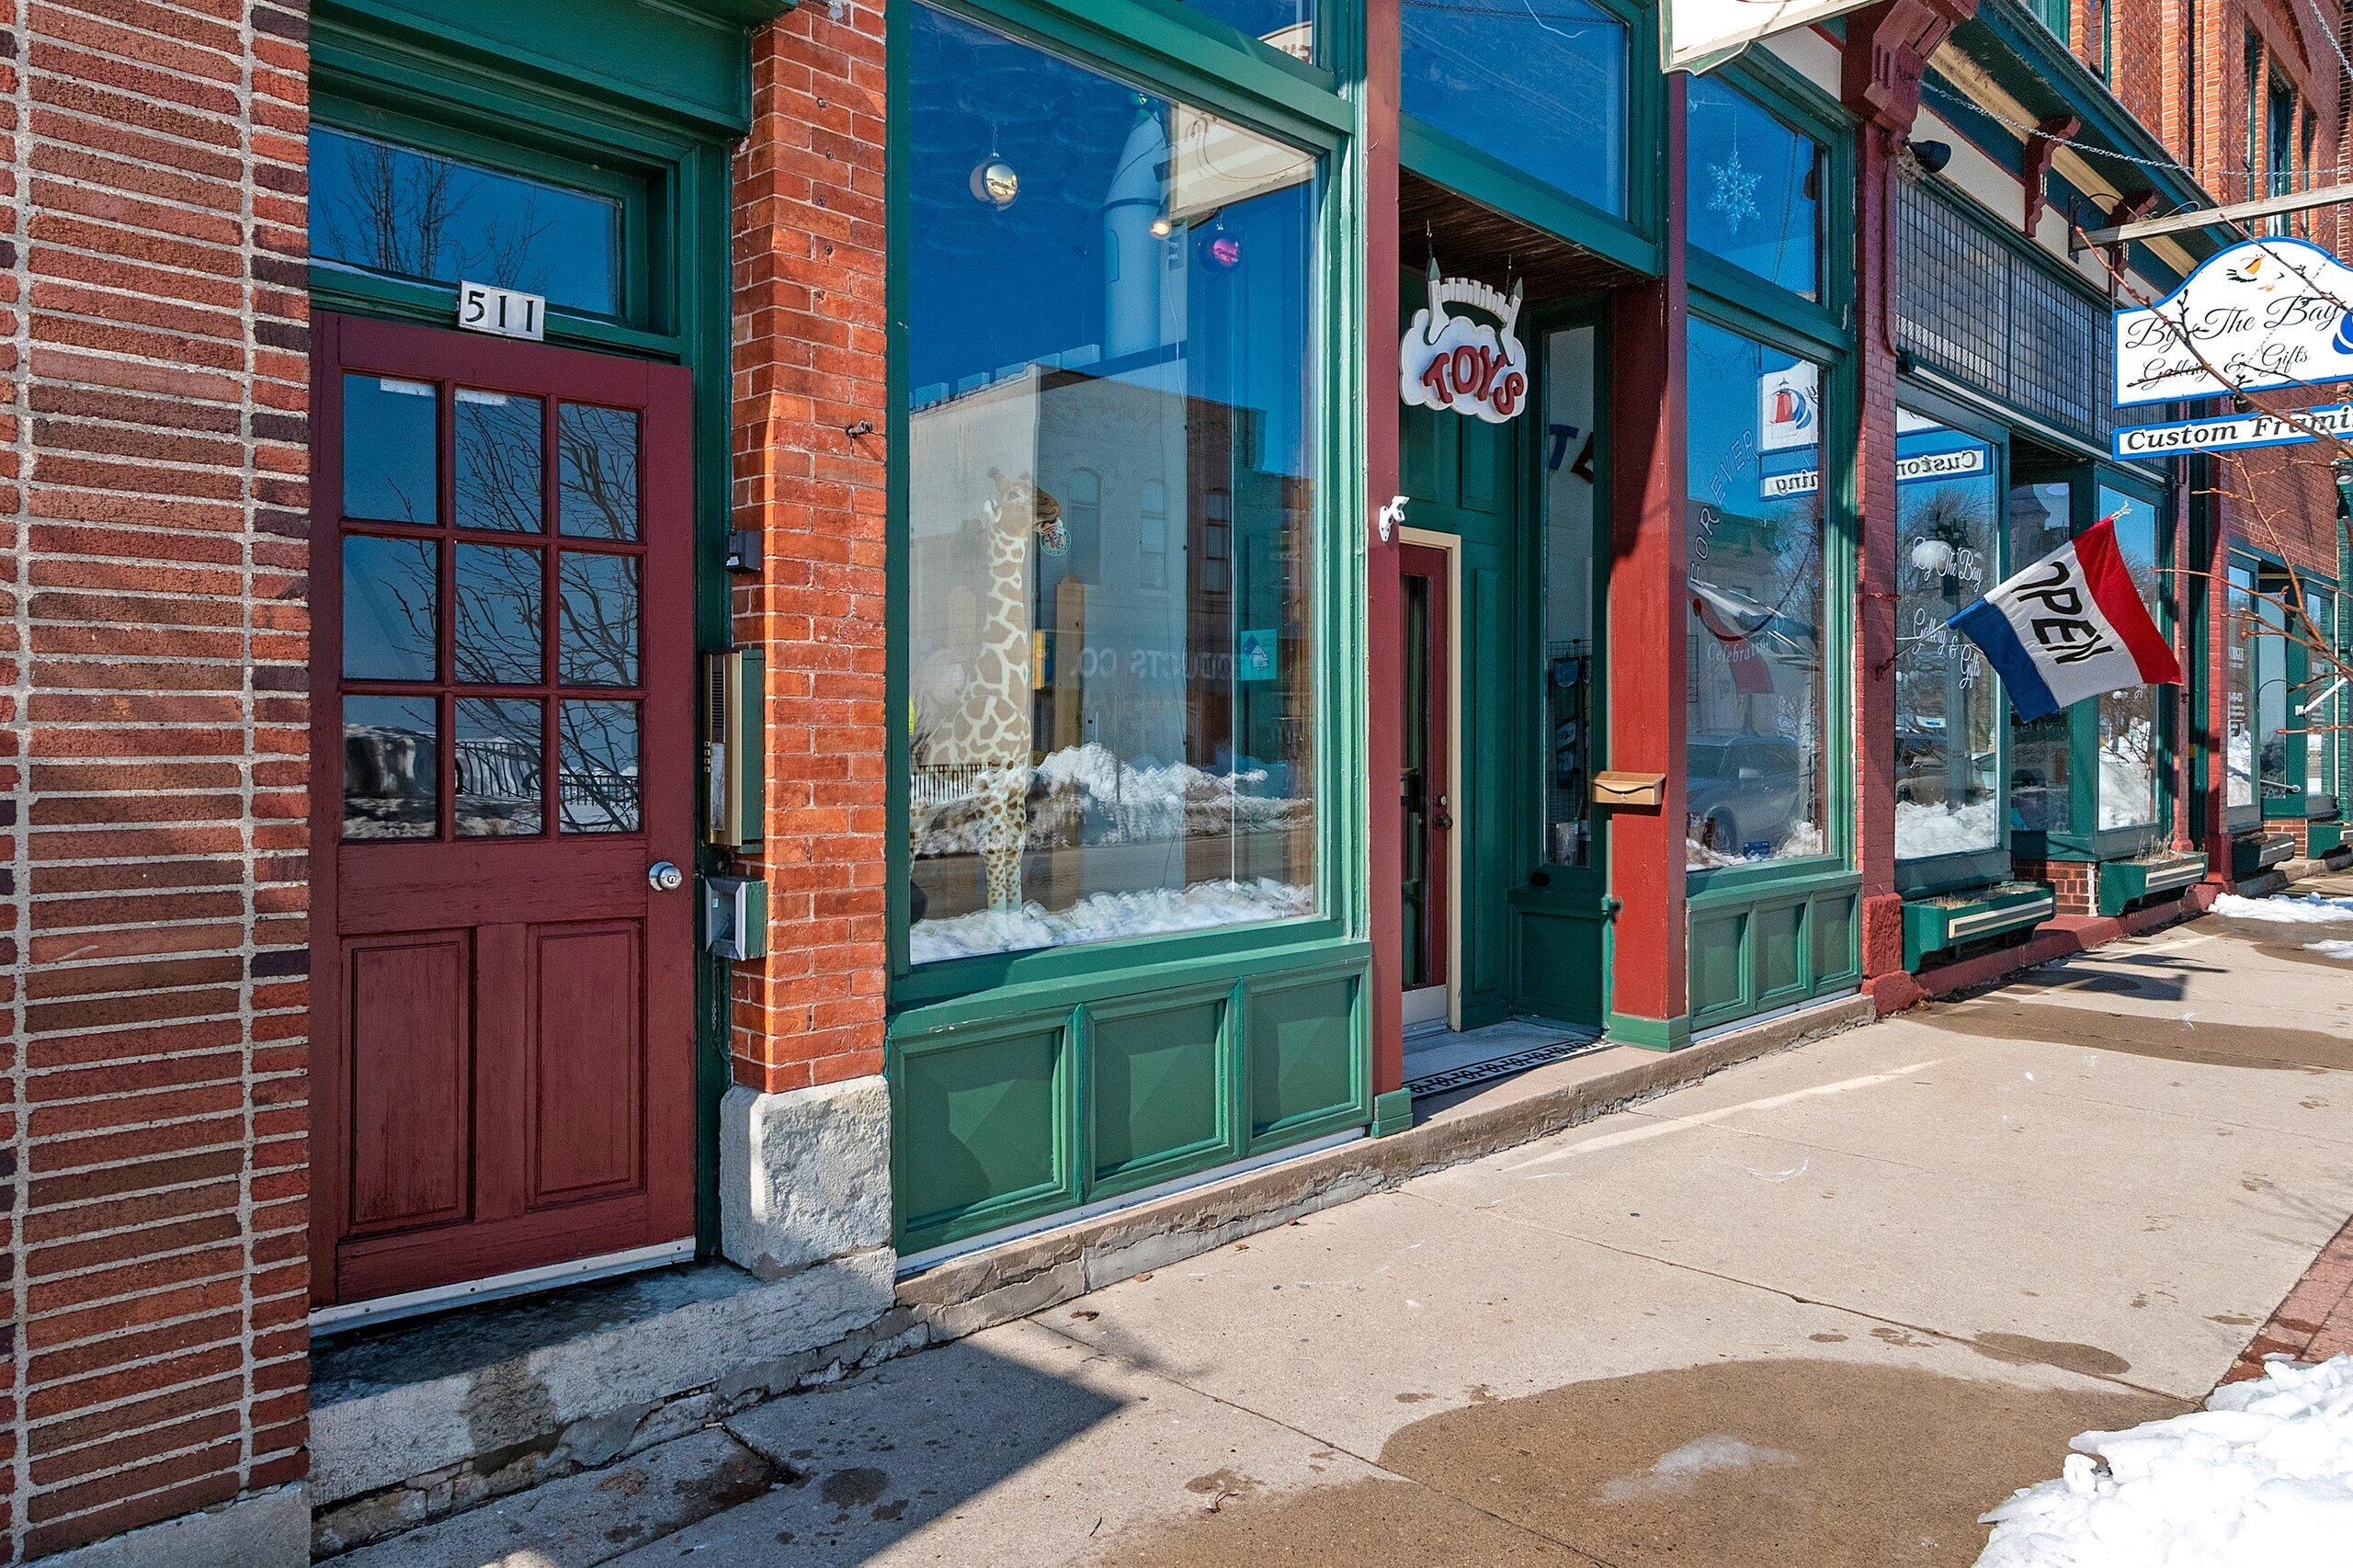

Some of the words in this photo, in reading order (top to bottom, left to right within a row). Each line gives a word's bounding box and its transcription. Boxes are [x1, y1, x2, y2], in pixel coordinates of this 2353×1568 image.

[465, 290, 534, 333] 511
[2125, 317, 2181, 354] By
[2193, 307, 2255, 340] The
[2264, 296, 2343, 332] Bay
[1423, 345, 1524, 415] TOYS
[2224, 352, 2245, 374] &
[2260, 343, 2310, 377] Gifts
[2128, 424, 2237, 450] Custom
[2252, 407, 2353, 437] Frami
[1936, 545, 1957, 577] The
[1959, 549, 1984, 592] Bay
[1960, 644, 1982, 689] Gifts
